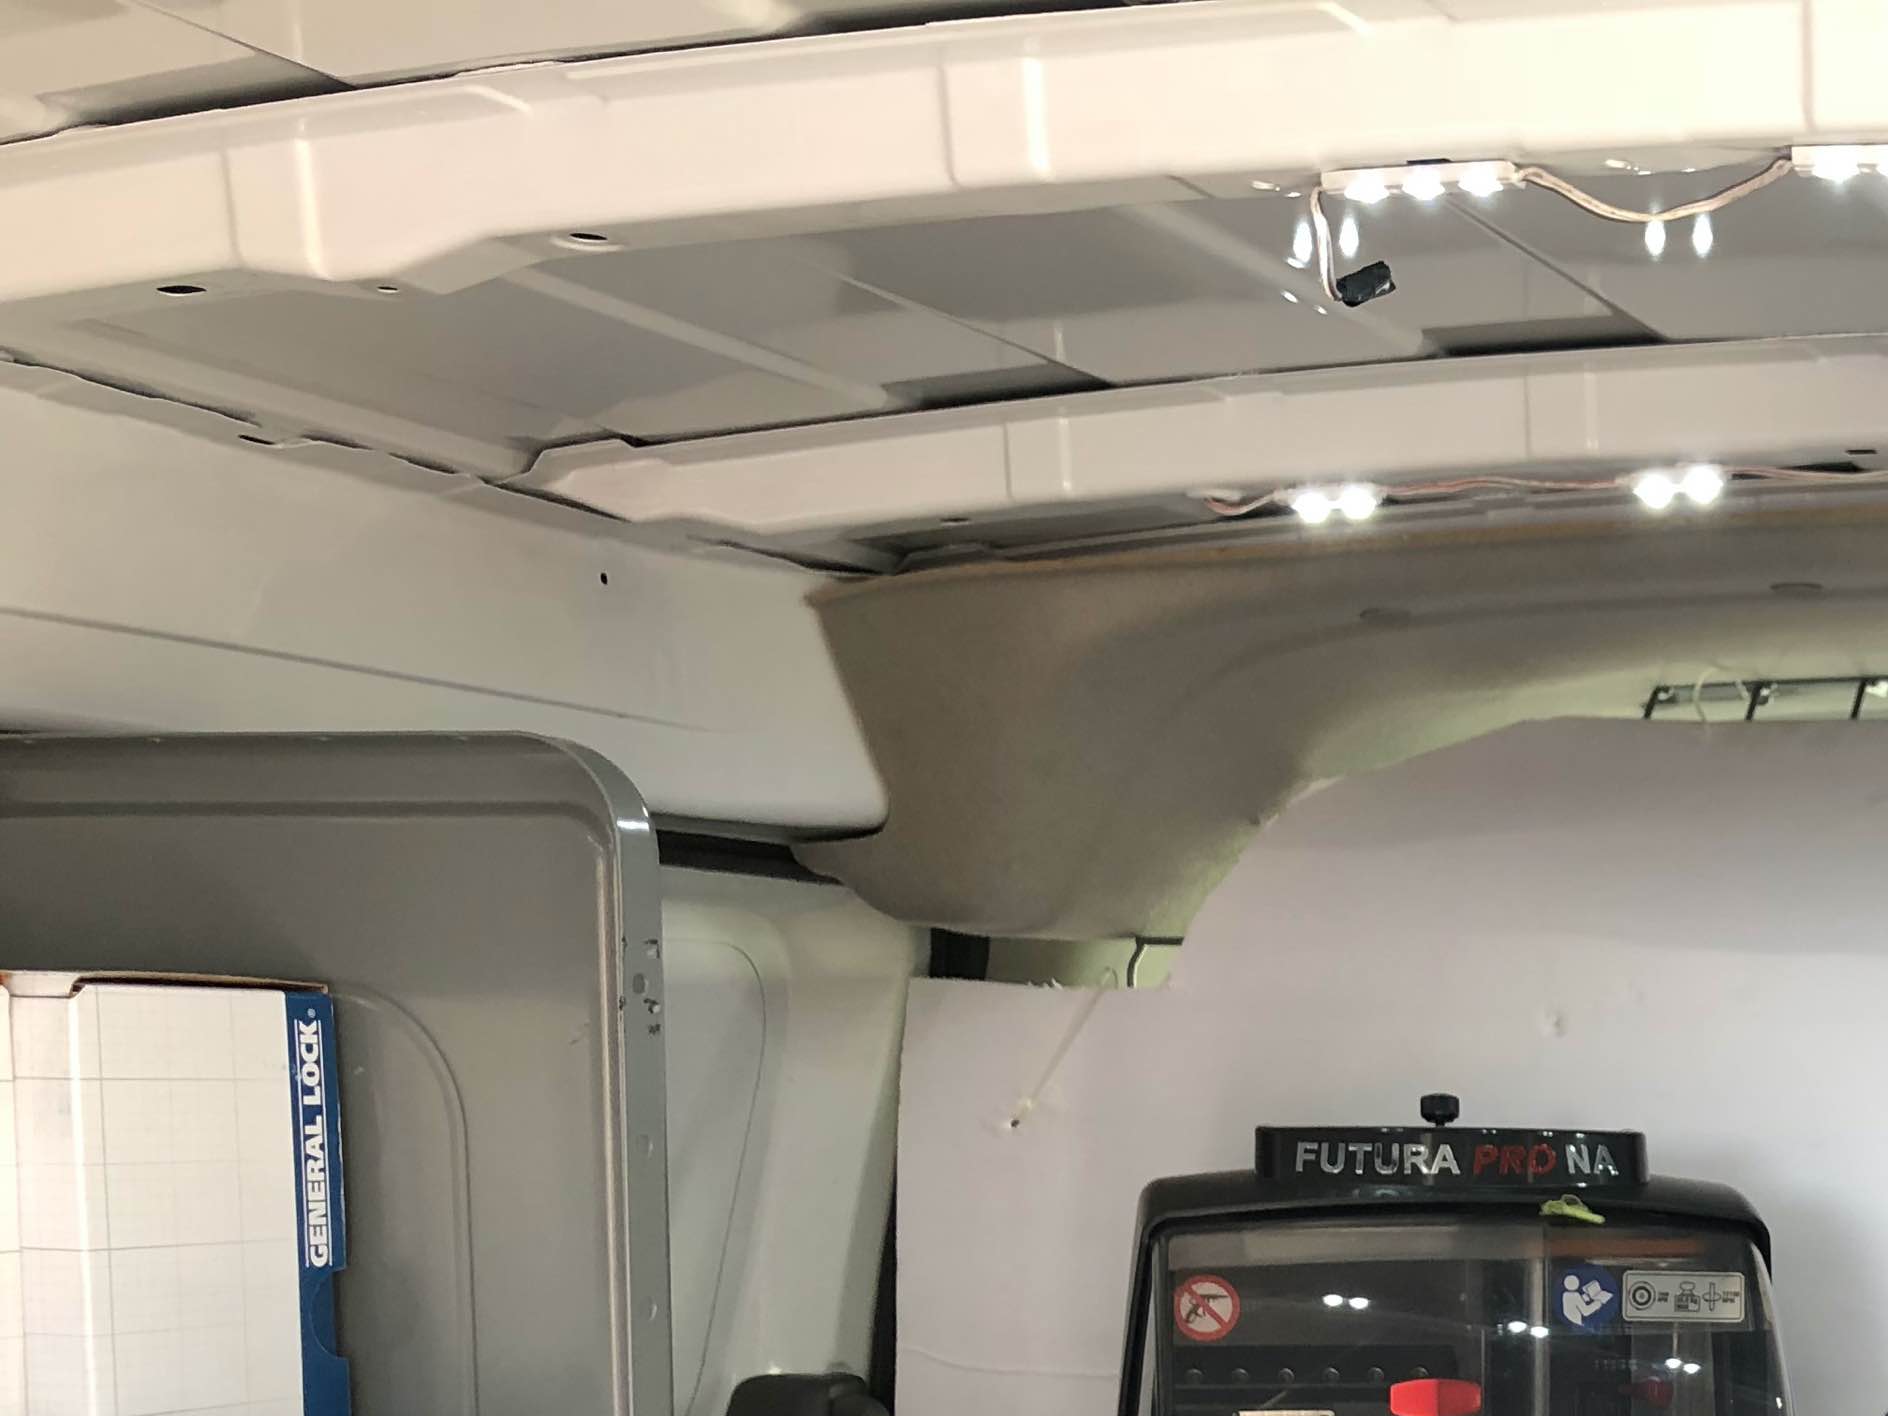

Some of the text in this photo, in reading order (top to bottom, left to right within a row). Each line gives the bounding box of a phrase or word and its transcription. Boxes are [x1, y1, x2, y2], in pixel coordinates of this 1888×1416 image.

[304, 1115, 329, 1268] GENERAL
[1295, 1142, 1620, 1176] FUTURA PRO NA
